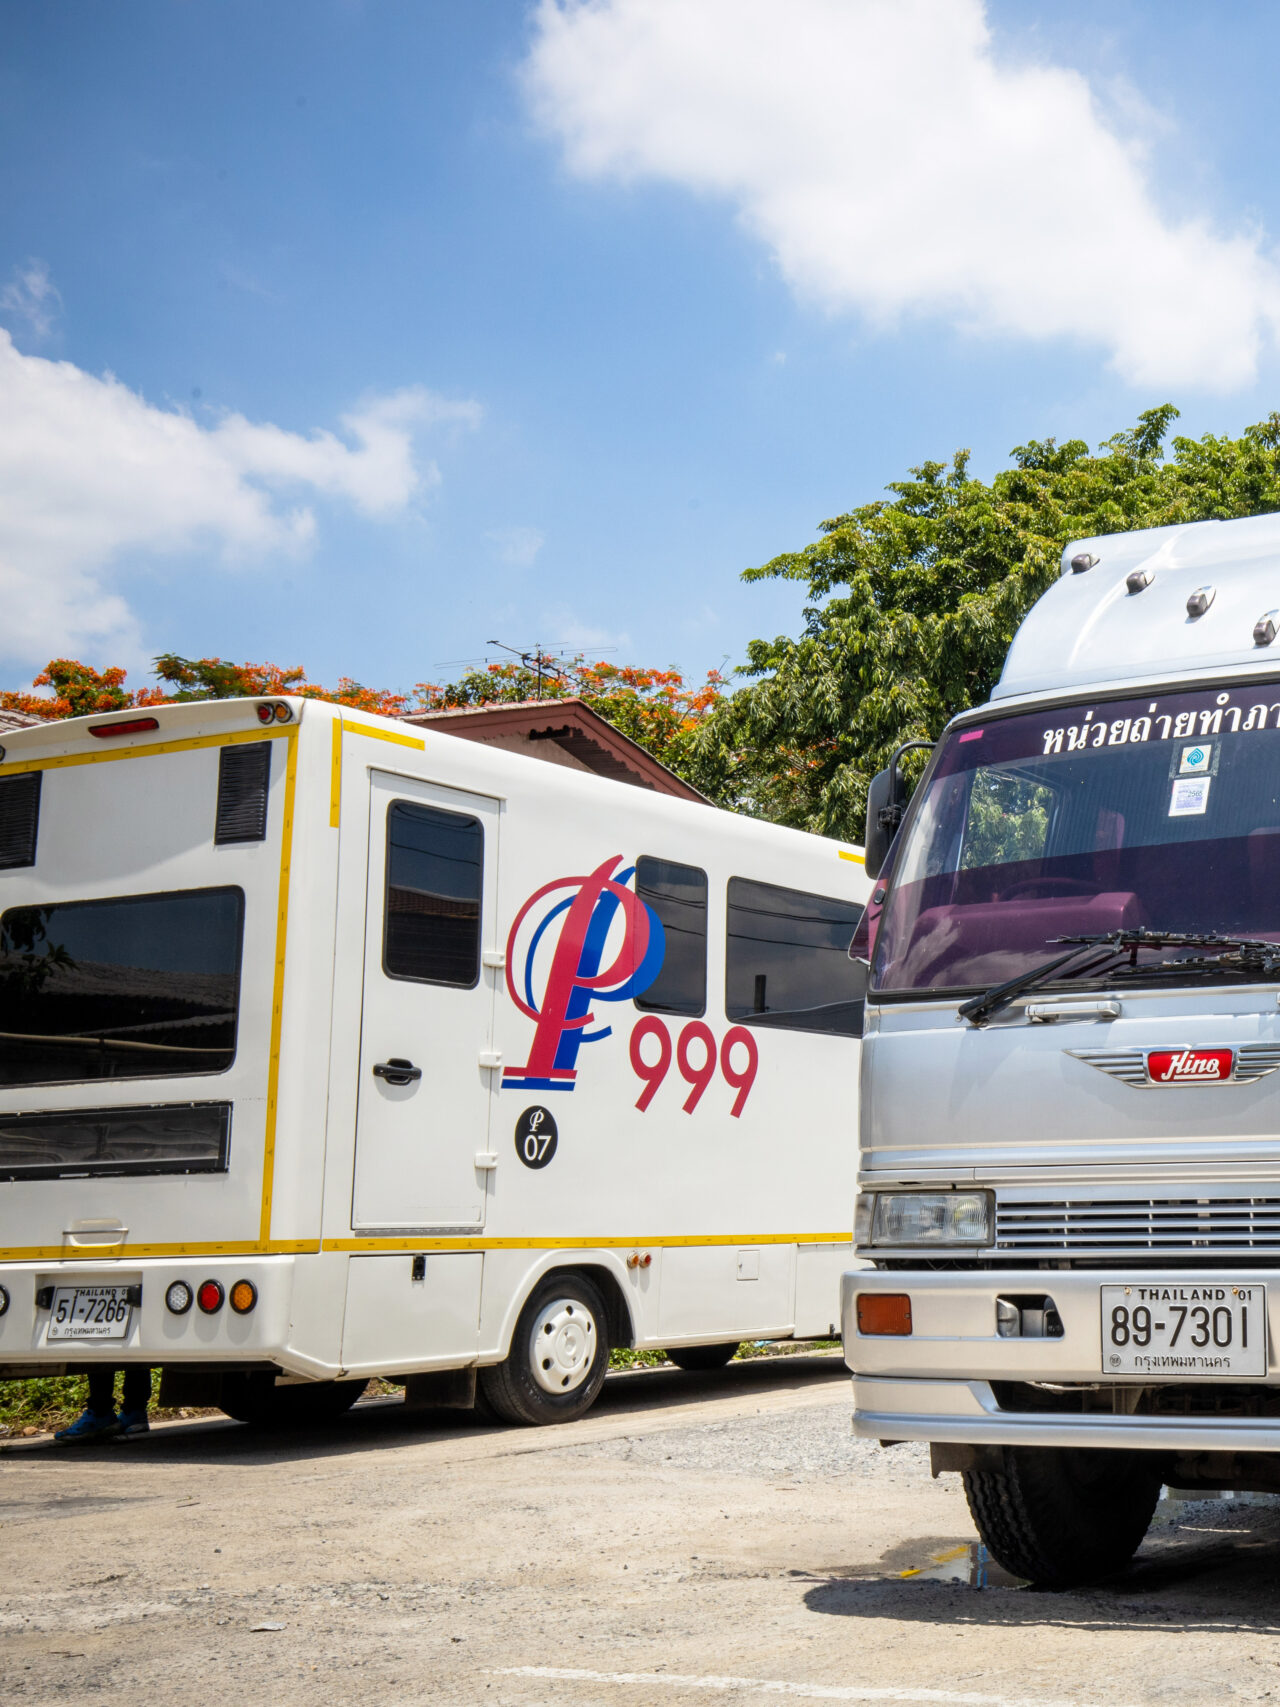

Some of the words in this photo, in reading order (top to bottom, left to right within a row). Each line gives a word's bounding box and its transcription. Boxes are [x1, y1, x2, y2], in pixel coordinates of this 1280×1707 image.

[629, 1015, 759, 1119] 999
[1161, 1050, 1220, 1080] Hino
[524, 1134, 552, 1161] 07
[75, 1288, 117, 1297] THAILAND
[1138, 1288, 1226, 1301] THAILAND
[1238, 1289, 1252, 1301] 01
[56, 1297, 128, 1324] 51-7266
[1110, 1305, 1249, 1348] 89-7301
[1134, 1355, 1231, 1370] กรุงเทพมหานคร
